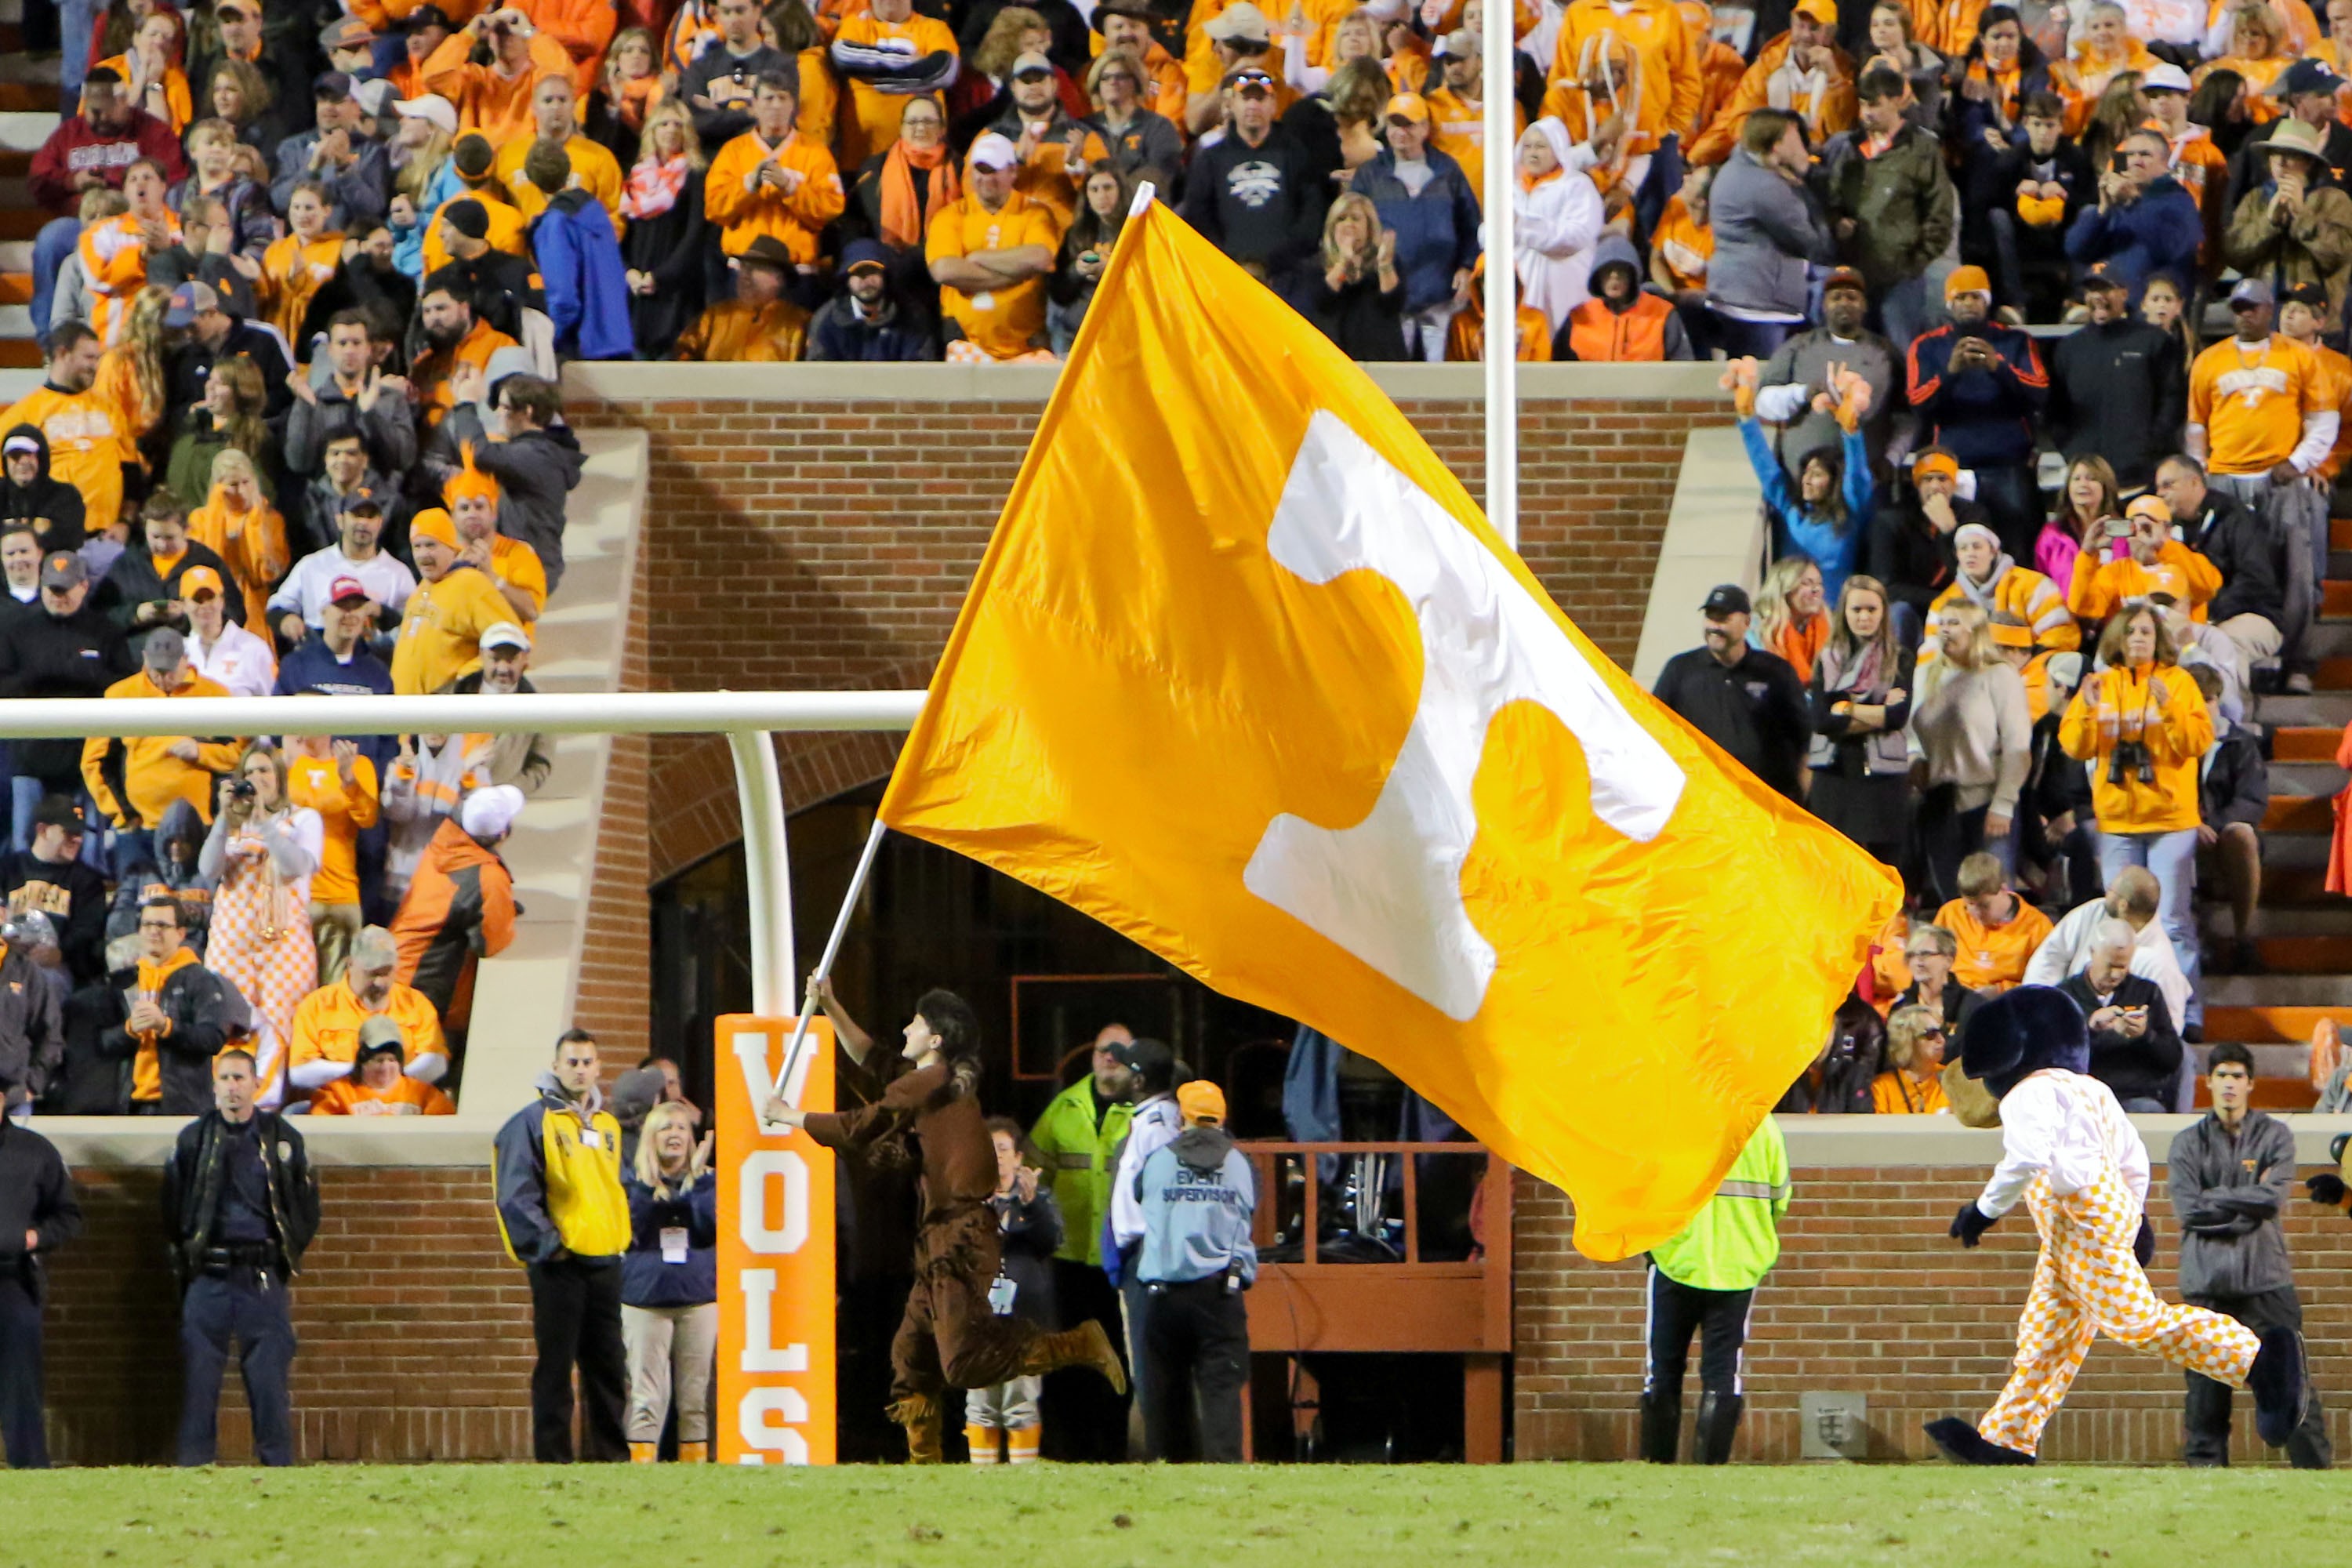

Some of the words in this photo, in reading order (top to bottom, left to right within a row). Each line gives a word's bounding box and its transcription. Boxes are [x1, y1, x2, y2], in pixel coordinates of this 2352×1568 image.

[1243, 408, 1687, 1022] T
[307, 769, 327, 788] T
[2241, 1159, 2258, 1173] T
[1163, 1187, 1236, 1205] SUPERVISOR
[732, 1032, 819, 1465] VOLS
